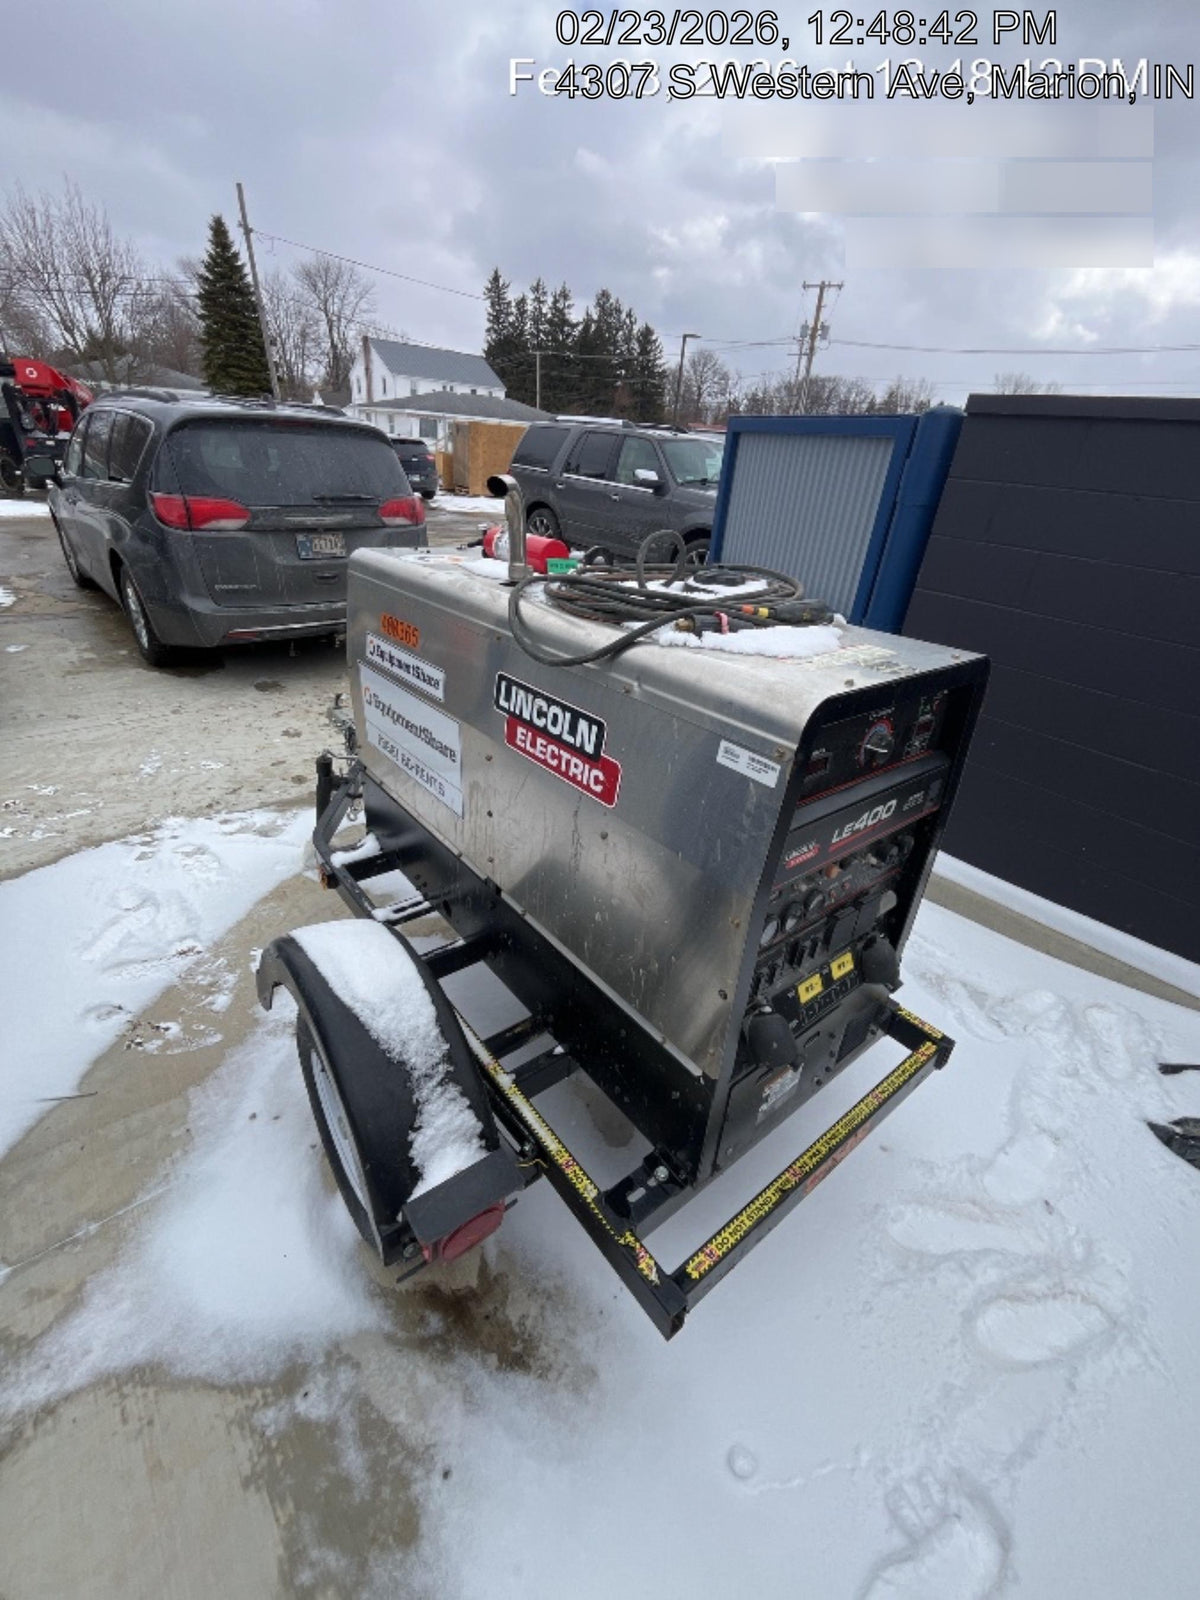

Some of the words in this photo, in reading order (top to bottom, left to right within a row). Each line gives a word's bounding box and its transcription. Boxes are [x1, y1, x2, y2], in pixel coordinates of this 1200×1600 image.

[372, 692, 457, 763] EquipmentShare
[499, 680, 598, 754] LINCOLN
[515, 726, 605, 793] ELECTRIC
[831, 799, 897, 843] LE400
